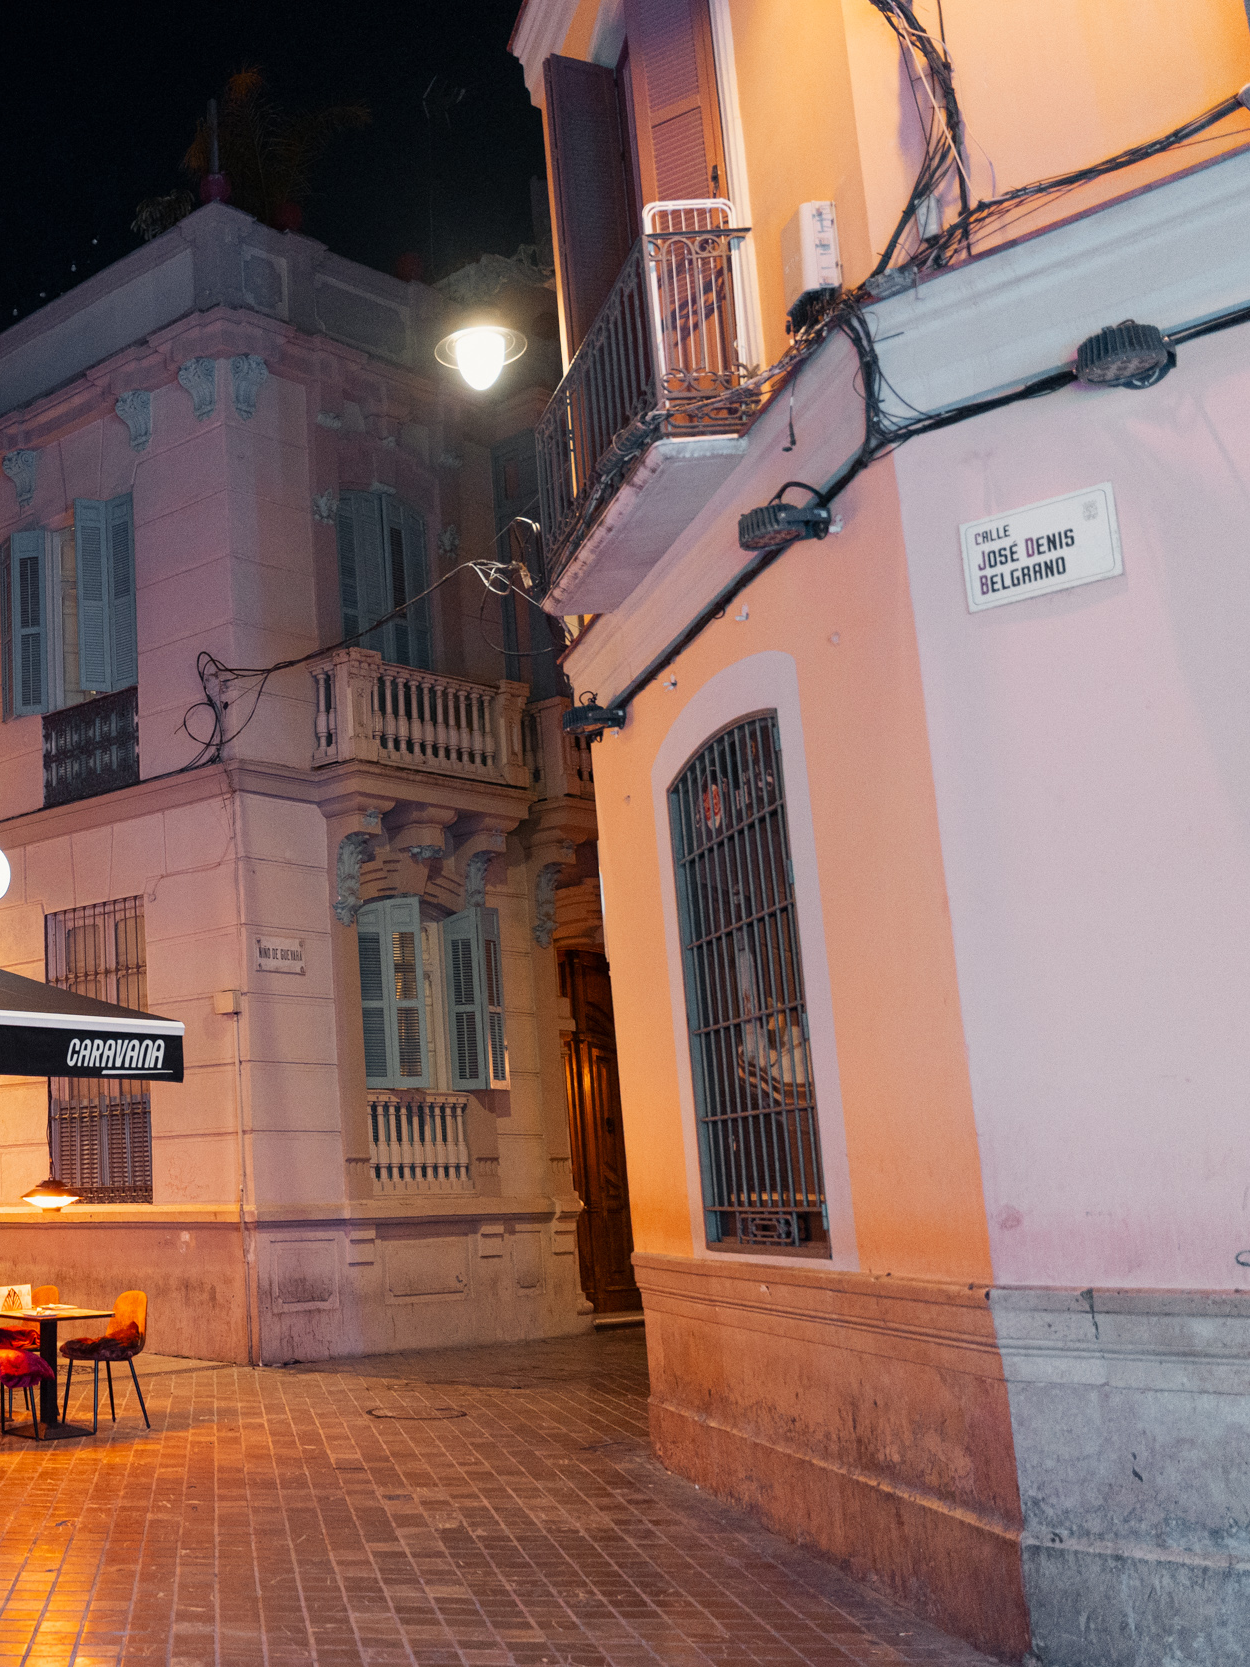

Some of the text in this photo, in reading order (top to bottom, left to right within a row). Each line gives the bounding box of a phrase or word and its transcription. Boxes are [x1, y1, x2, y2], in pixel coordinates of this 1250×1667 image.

[974, 524, 1011, 546] CALLE
[977, 528, 1075, 571] JOSÉ DENIS
[979, 556, 1067, 596] BELGRANO
[272, 948, 279, 960] DE
[66, 1038, 165, 1068] CARAVANA
